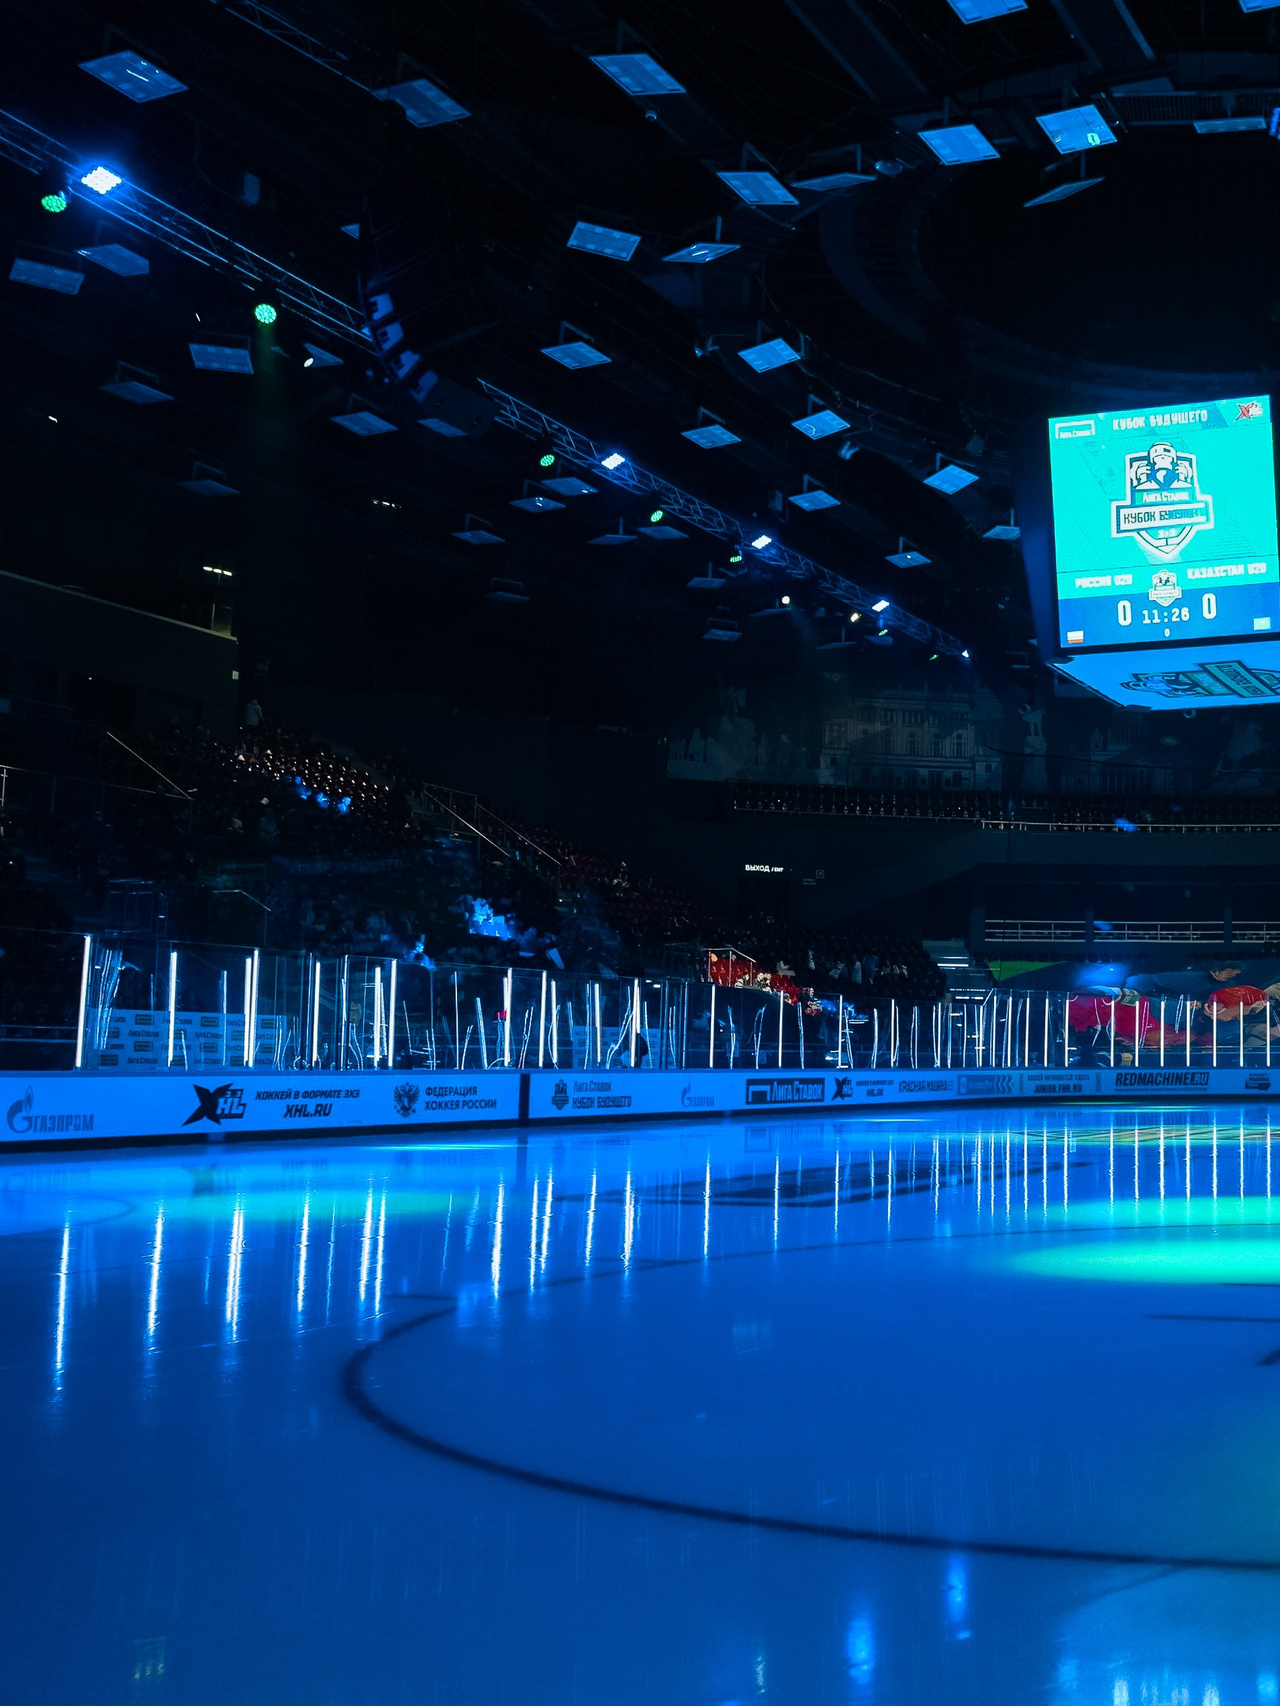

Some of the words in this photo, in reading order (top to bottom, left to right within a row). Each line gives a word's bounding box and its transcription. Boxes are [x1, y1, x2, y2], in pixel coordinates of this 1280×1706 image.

[1112, 416, 1146, 431] КУБОК
[1149, 409, 1209, 428] БУДУЩЕГО
[1123, 511, 1156, 524] КУБОК
[1187, 564, 1245, 580] КАЗАХСТАН
[1117, 600, 1132, 626] 0
[1202, 593, 1217, 620] 0
[1142, 606, 1190, 624] 11:26
[745, 864, 770, 873] ВЫХОД
[1115, 1072, 1209, 1087] REDMACHINE.RU
[255, 1088, 292, 1100] ХОККЕЙ
[293, 1090, 300, 1099] В
[301, 1089, 343, 1100] ФОРМАТЕ
[425, 1086, 477, 1098] ФЕДЕРАЦИЯ
[1034, 1084, 1082, 1094] JUNIOR.FHR.RU
[424, 1099, 460, 1111] ХОККЕЯ
[462, 1098, 497, 1110] РОССИИ
[572, 1096, 595, 1109] КУБОК
[283, 1103, 333, 1118] XHL.RU
[33, 1114, 94, 1134] ГАЗПРОМ
